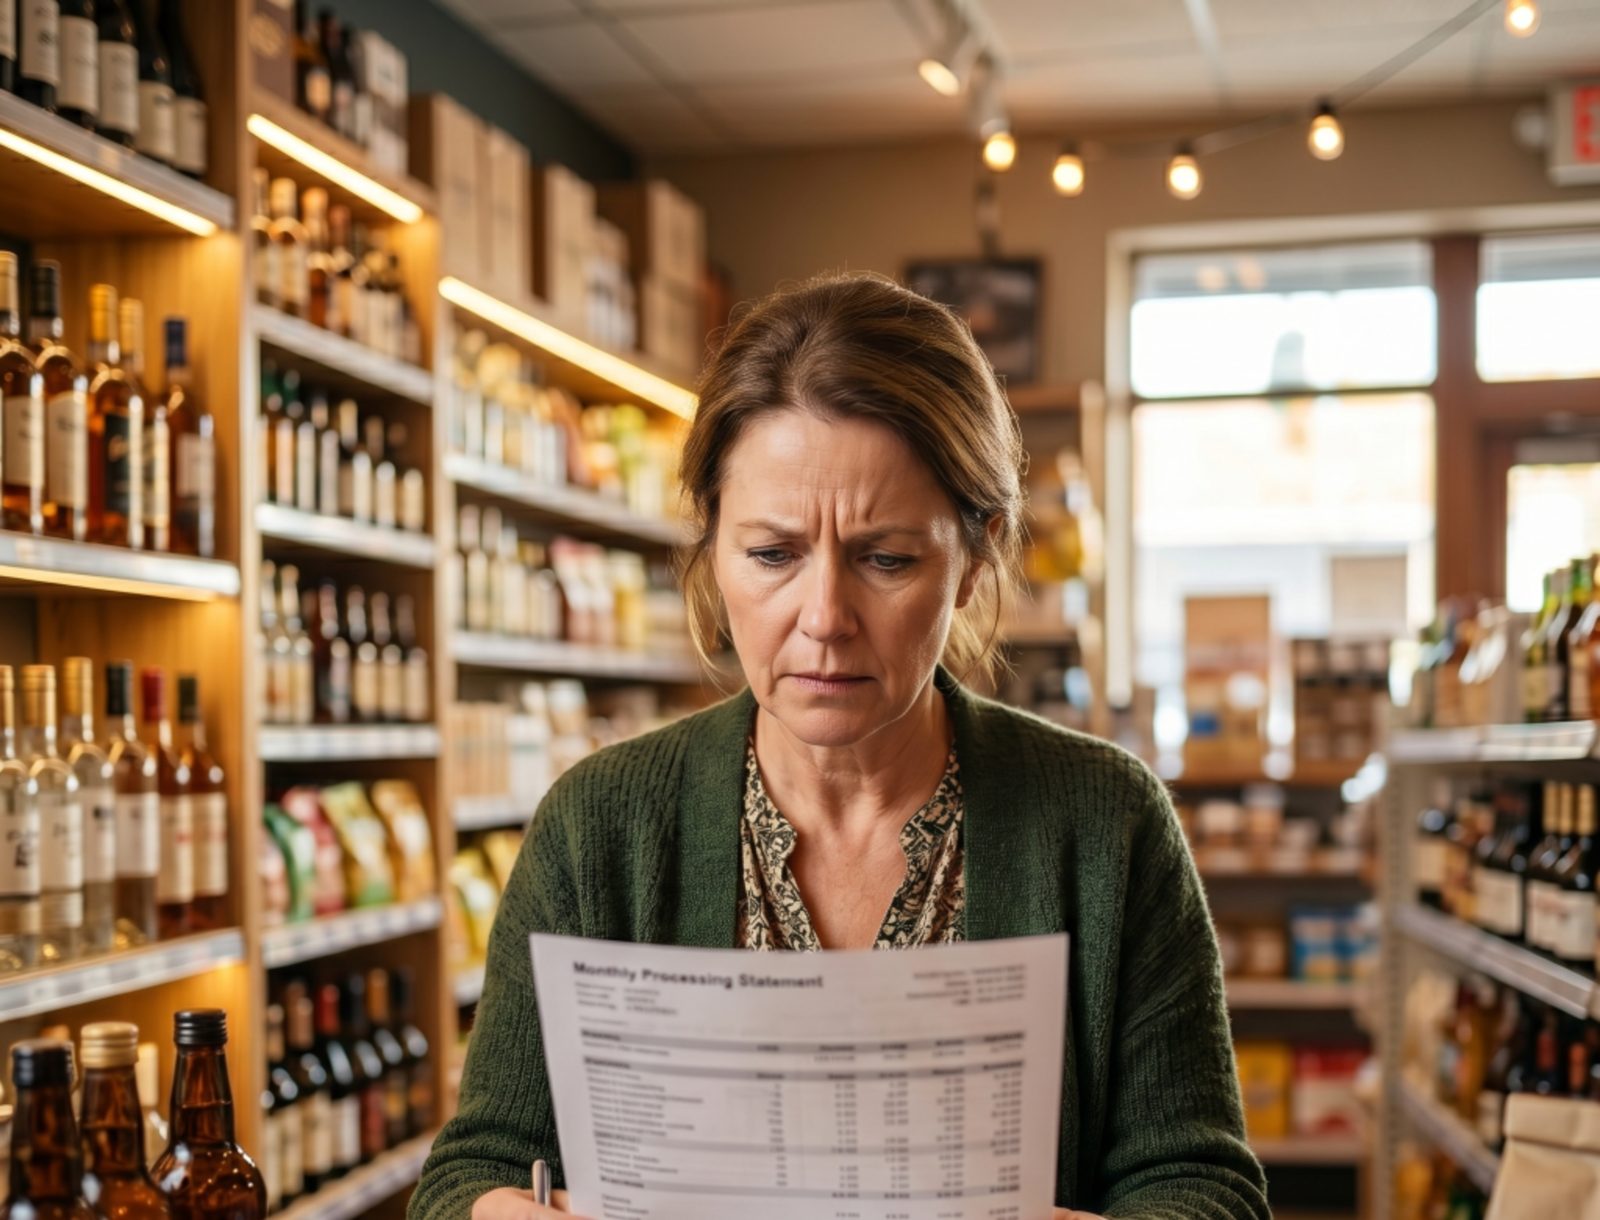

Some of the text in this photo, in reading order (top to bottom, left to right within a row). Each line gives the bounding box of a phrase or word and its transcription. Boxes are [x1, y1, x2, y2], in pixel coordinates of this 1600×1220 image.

[573, 962, 823, 989] Monthly Processing Statement
